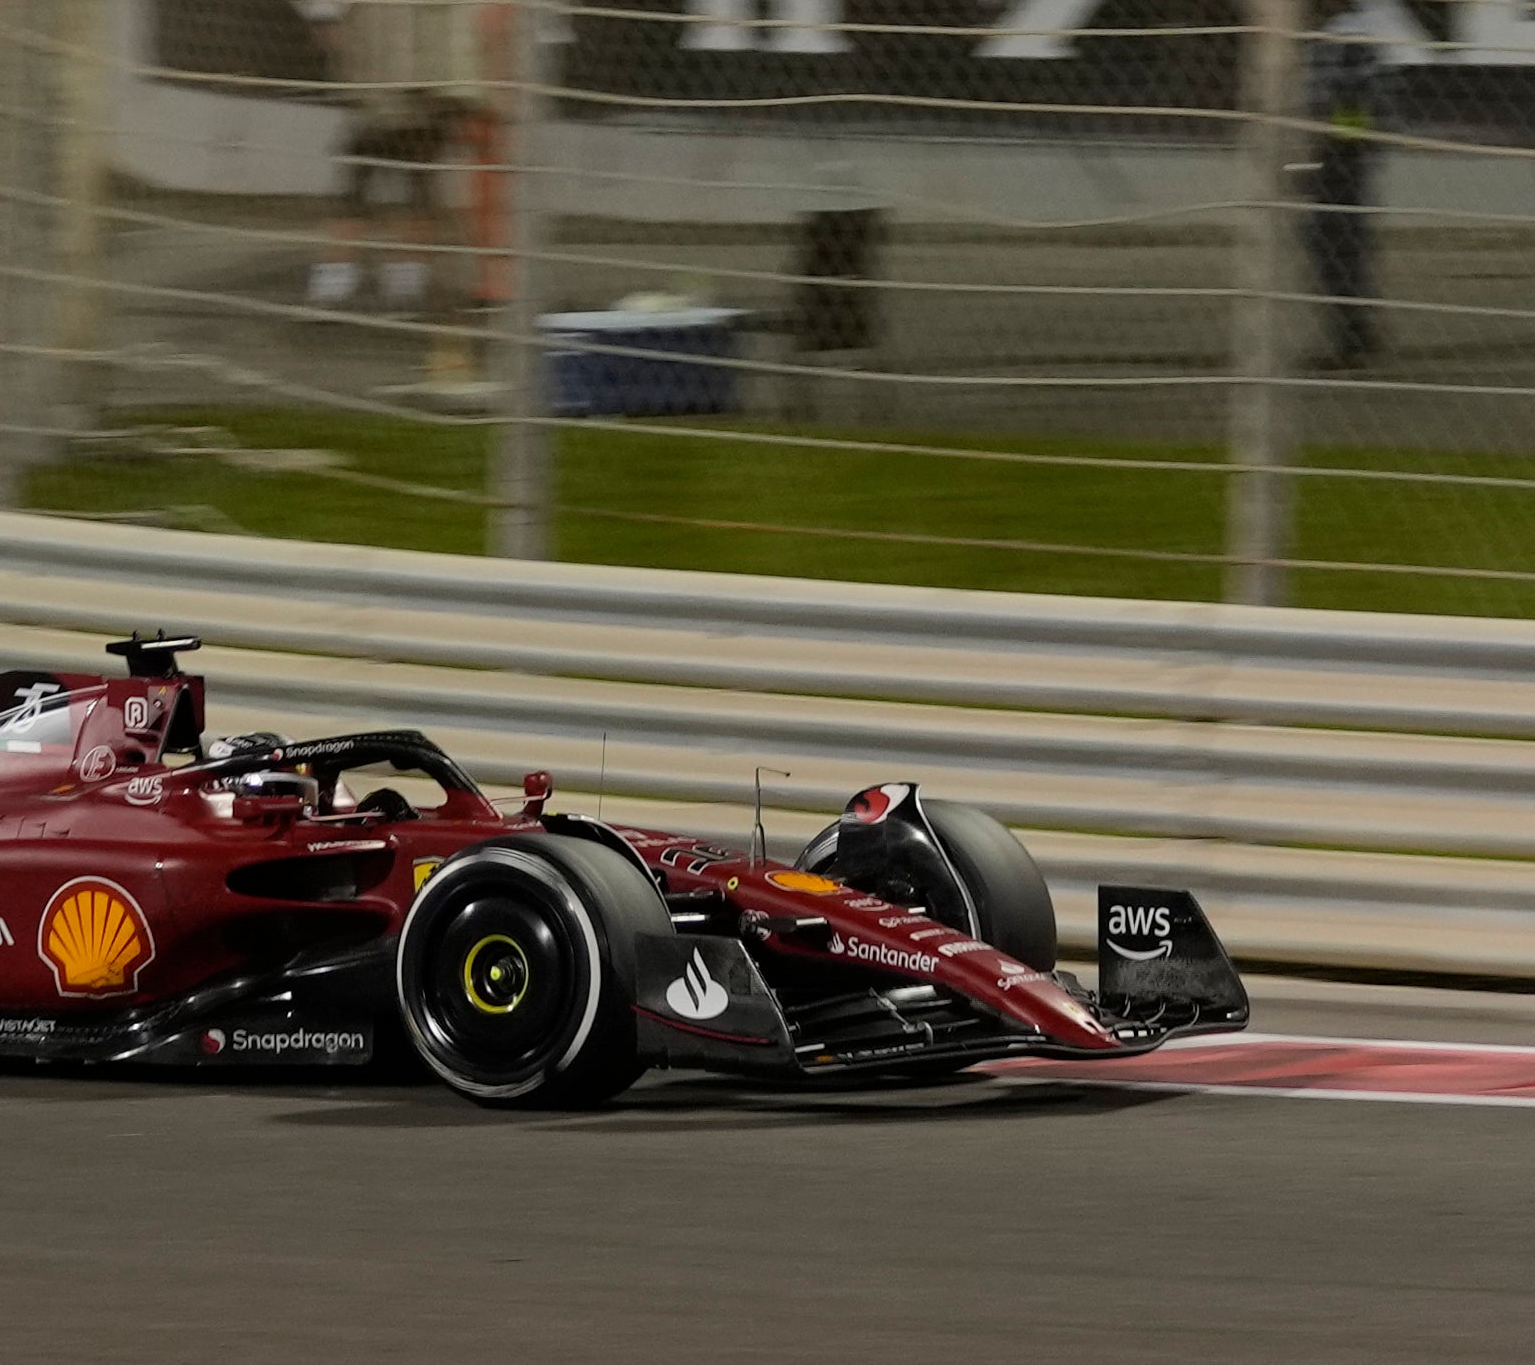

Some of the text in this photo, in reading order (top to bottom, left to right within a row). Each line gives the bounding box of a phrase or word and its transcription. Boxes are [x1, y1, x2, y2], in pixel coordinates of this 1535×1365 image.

[286, 739, 355, 758] Snapdragon
[128, 777, 163, 794] aws
[1108, 904, 1170, 937] aws
[847, 936, 940, 973] Santander
[232, 1027, 364, 1054] Snapdragon
